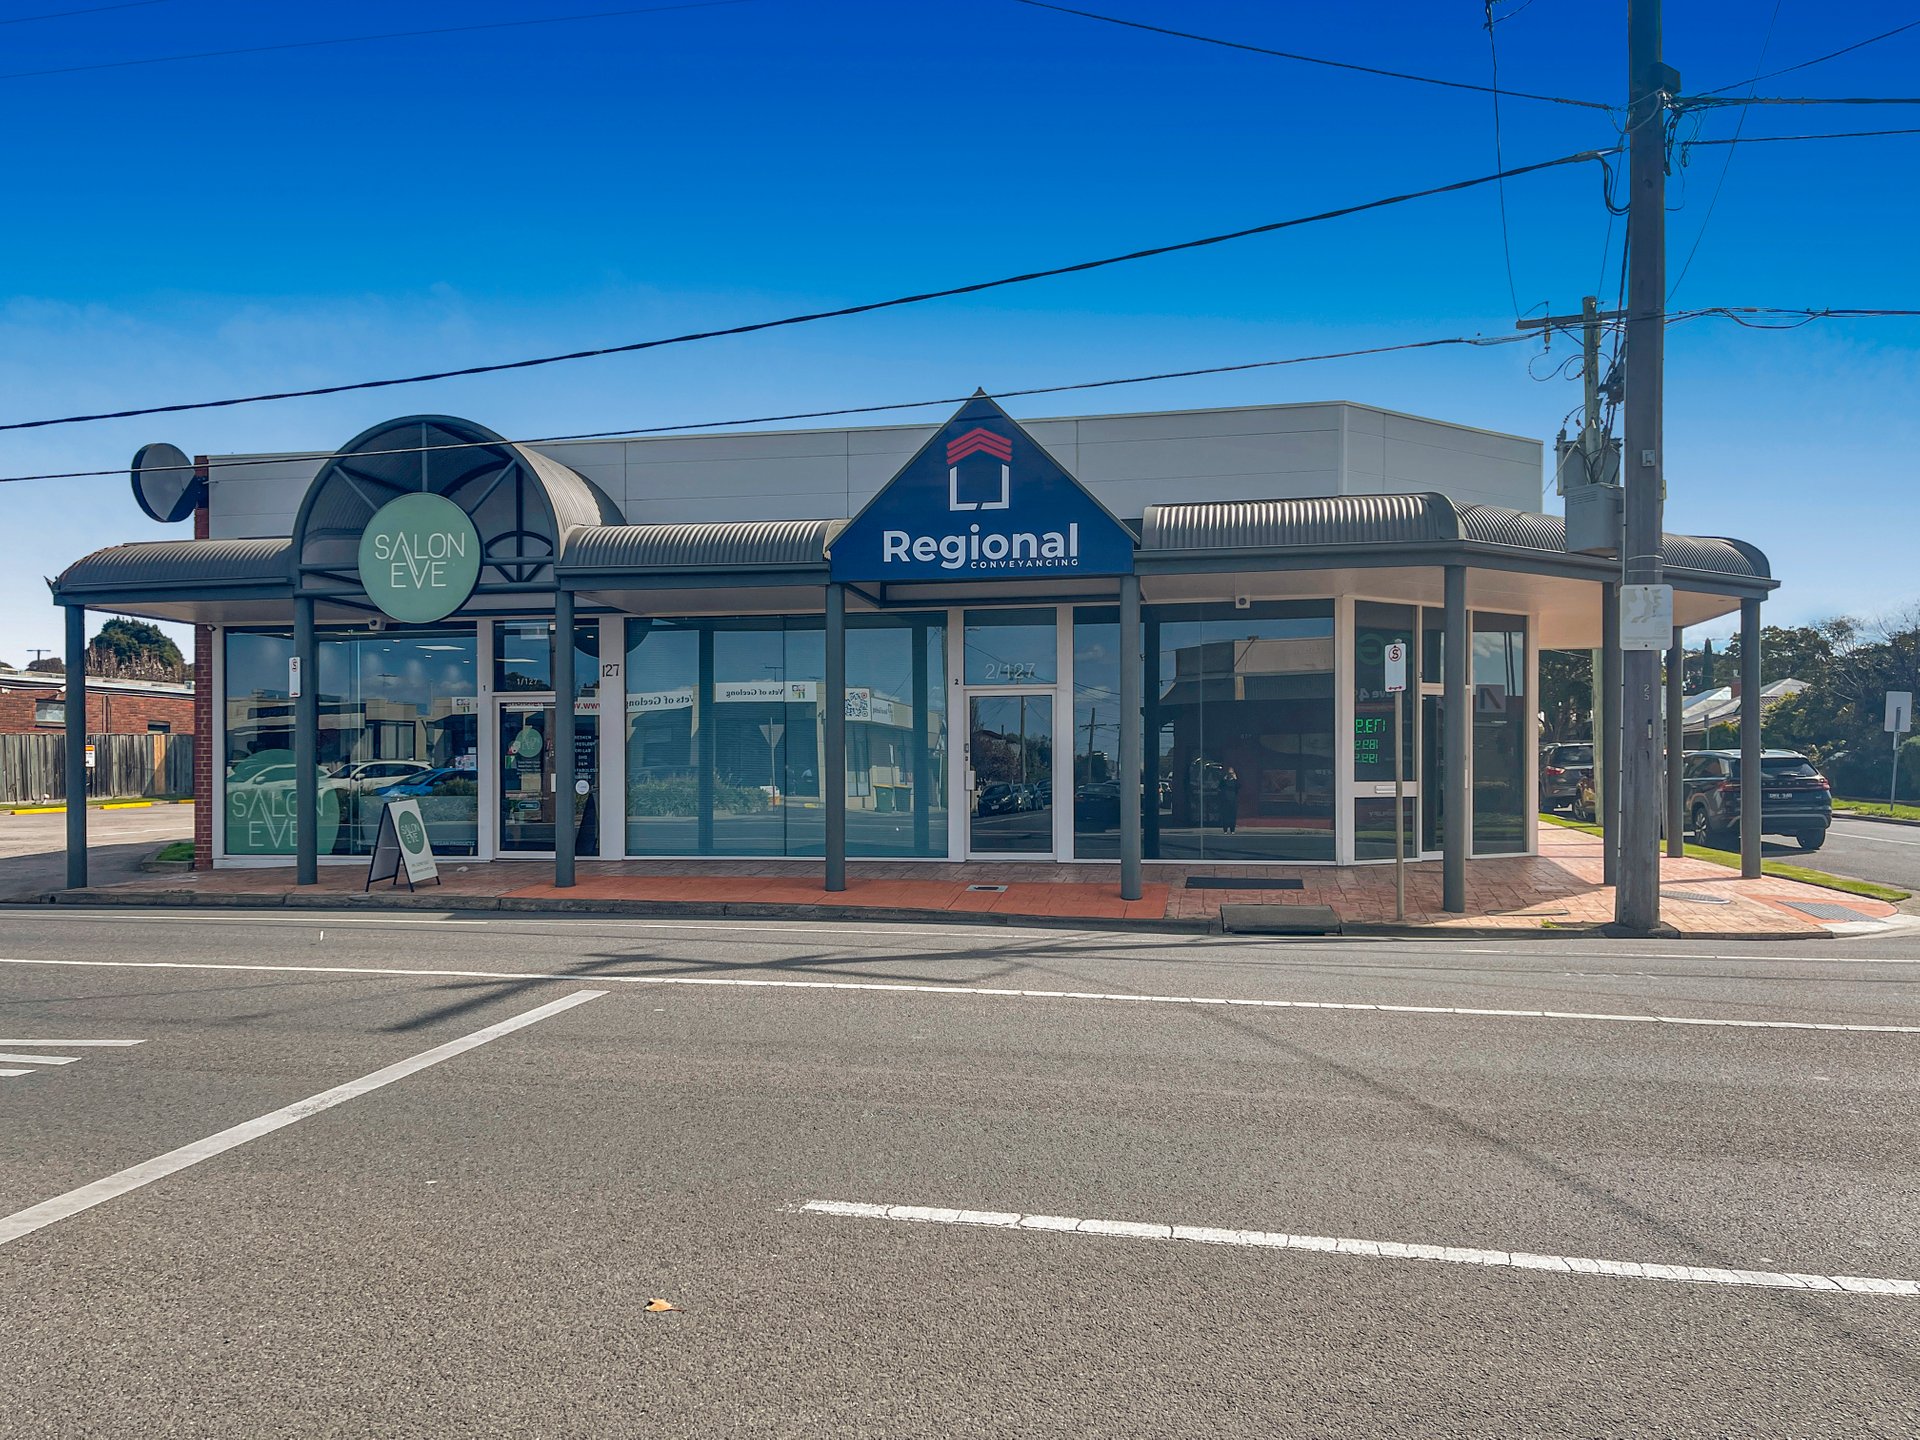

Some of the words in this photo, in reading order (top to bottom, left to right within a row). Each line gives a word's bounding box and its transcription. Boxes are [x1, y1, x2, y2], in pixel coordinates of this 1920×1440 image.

[375, 531, 465, 560] SALON
[883, 522, 1078, 569] Regional
[970, 558, 1079, 568] CONVEYANCING
[391, 560, 447, 589] EVE
[602, 663, 620, 678] 127
[984, 662, 1036, 680] 2/127
[516, 678, 538, 686] 1/127
[954, 678, 960, 686] 2
[248, 819, 298, 849] EVE
